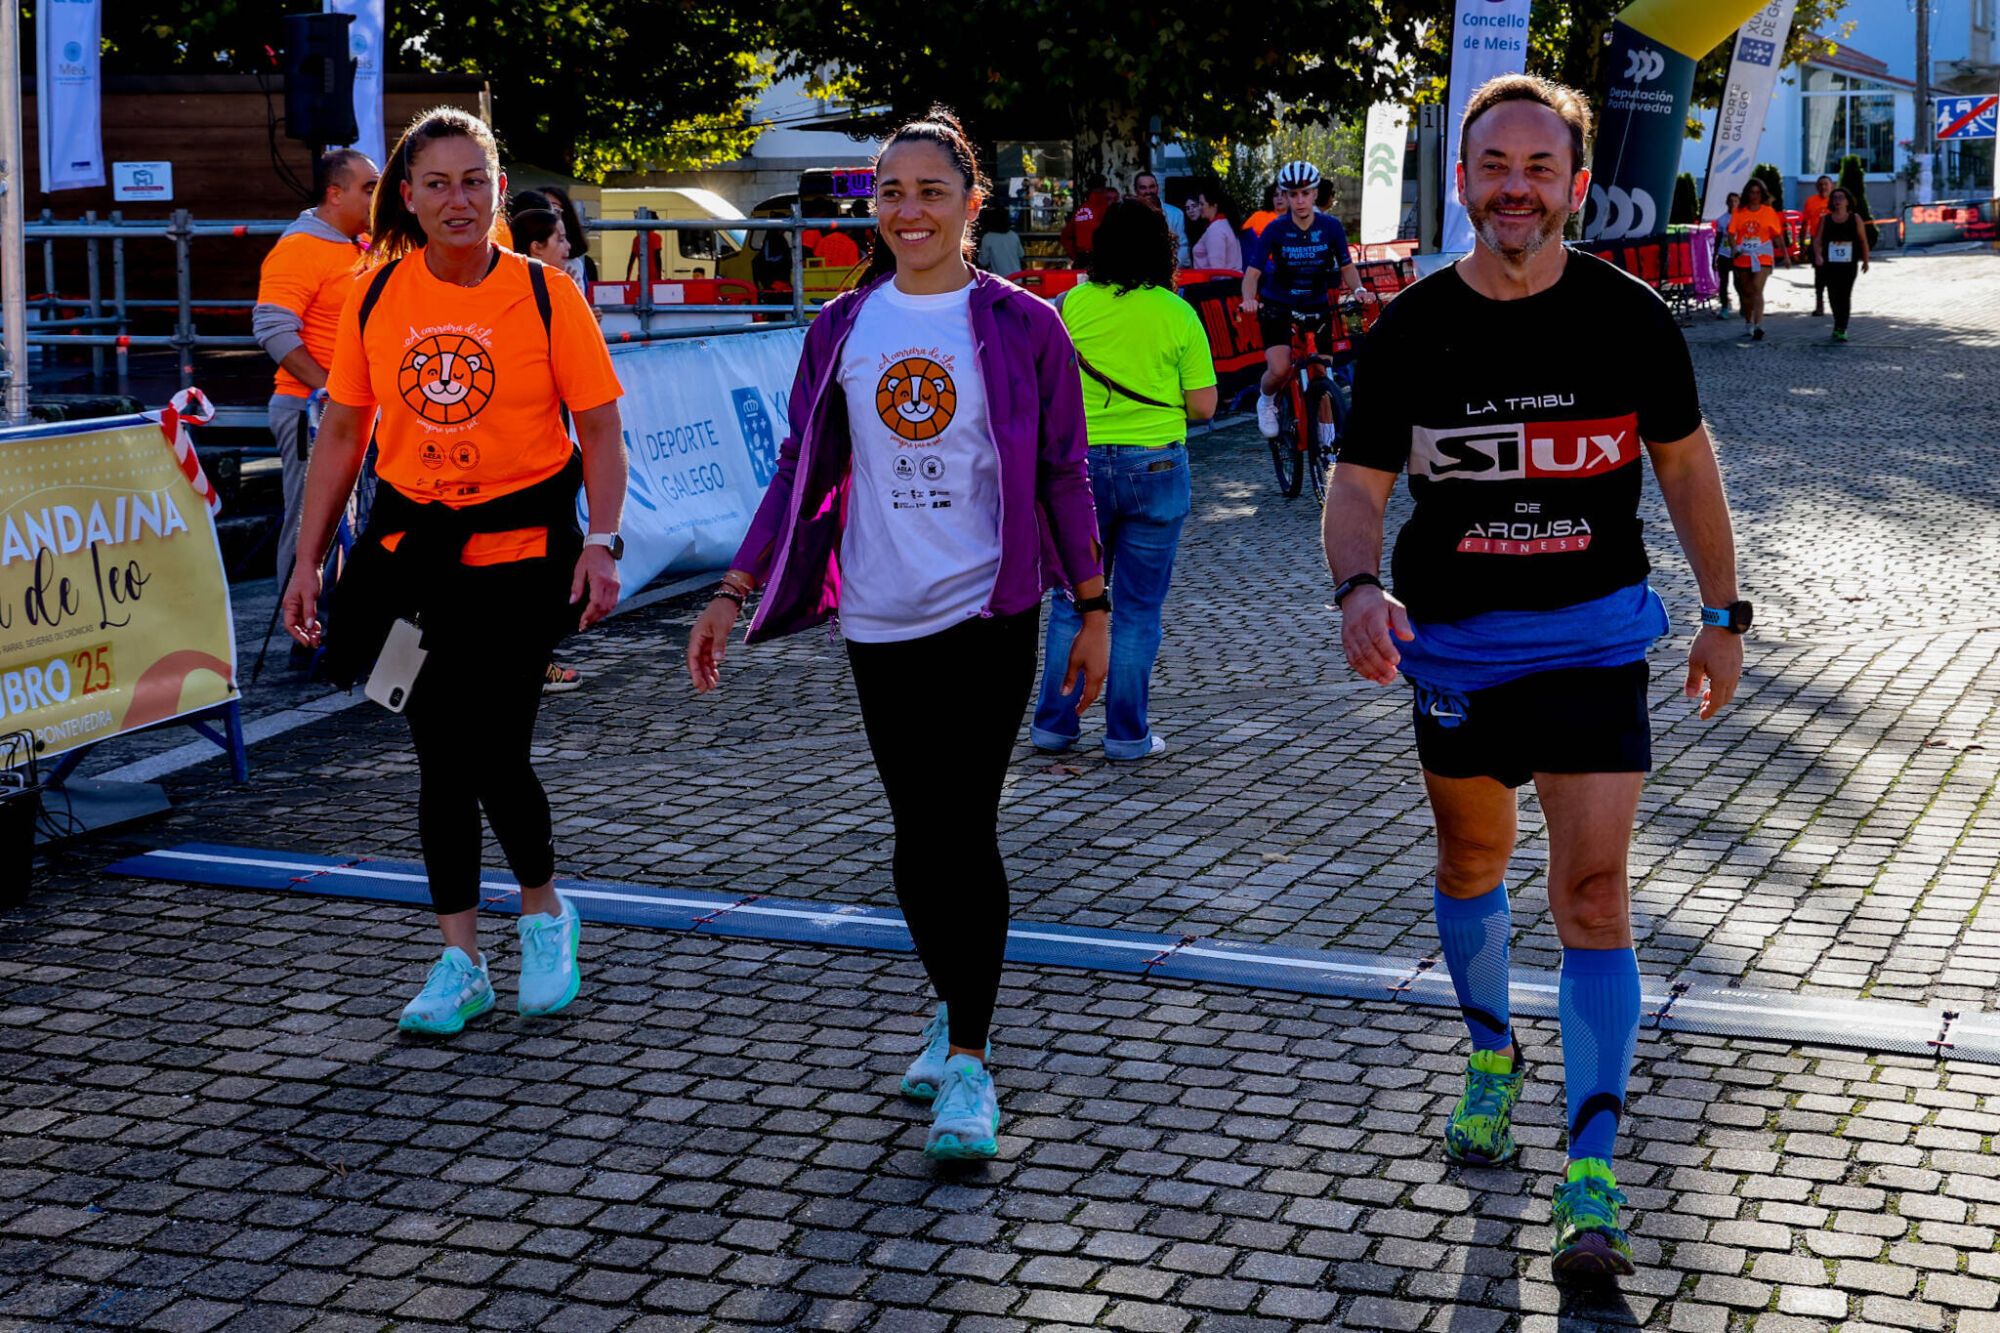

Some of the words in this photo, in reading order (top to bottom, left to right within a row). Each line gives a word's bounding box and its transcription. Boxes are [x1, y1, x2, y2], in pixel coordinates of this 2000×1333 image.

[1462, 11, 1526, 29] Concello
[1463, 35, 1479, 50] de
[1481, 36, 1521, 51] Meis
[59, 63, 87, 76] Meis
[1609, 87, 1674, 103] Deputación
[1607, 99, 1672, 115] Pontevedra
[1722, 83, 1741, 140] DEPORTE
[1732, 91, 1749, 142] GALEGO
[1465, 400, 1498, 416] LA
[1505, 393, 1575, 411] TRIBU
[645, 419, 720, 462] DEPORTE
[661, 462, 725, 501] GALEGO
[1515, 502, 1541, 513] DE
[1, 491, 188, 566] ANDAINA
[1465, 518, 1592, 540] AROUSA
[1464, 538, 1586, 553] FITNESS
[24, 546, 80, 627] de
[90, 540, 152, 630] Leo
[0, 658, 71, 719] BRO
[36, 708, 113, 744] PONTEVEDRA
